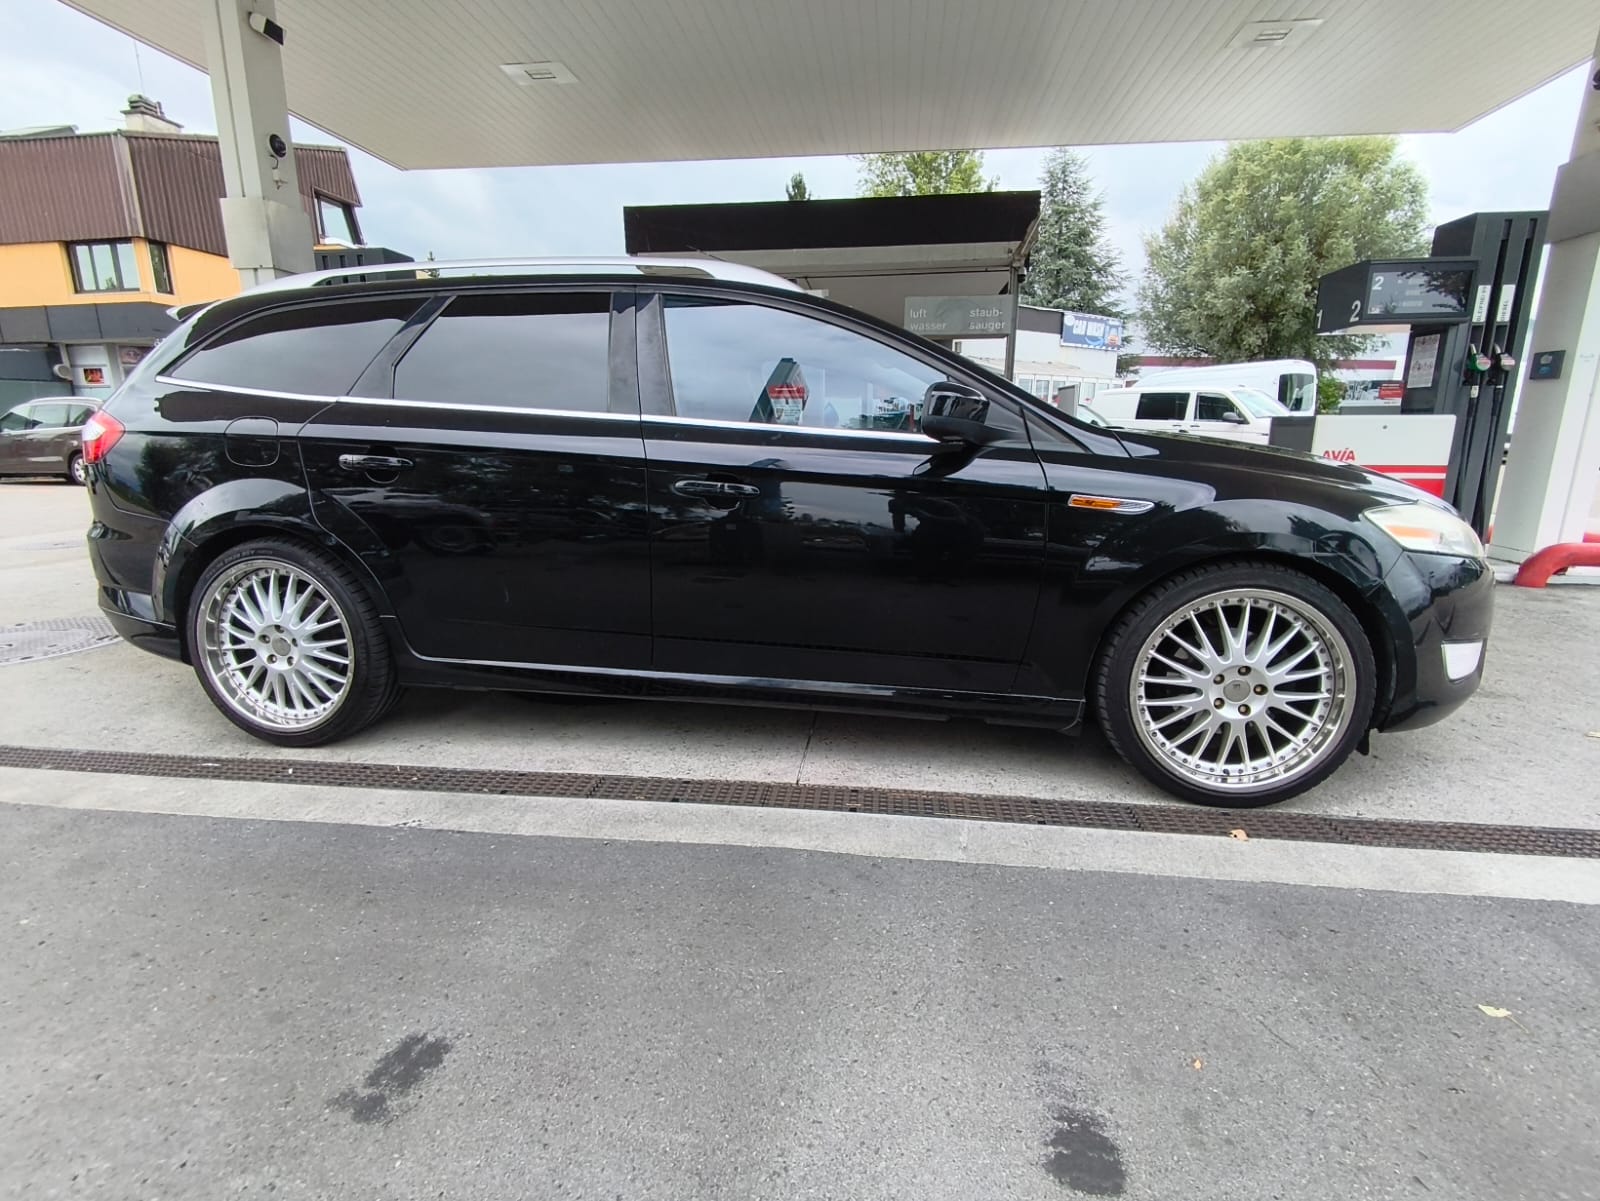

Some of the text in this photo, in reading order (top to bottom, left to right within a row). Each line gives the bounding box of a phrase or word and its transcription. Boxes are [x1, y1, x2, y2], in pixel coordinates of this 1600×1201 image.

[1372, 276, 1384, 290] 2
[909, 309, 927, 318] luft
[1350, 300, 1361, 322] 2
[1316, 309, 1323, 328] 1
[910, 321, 946, 331] wasser
[968, 320, 1006, 332] sauger
